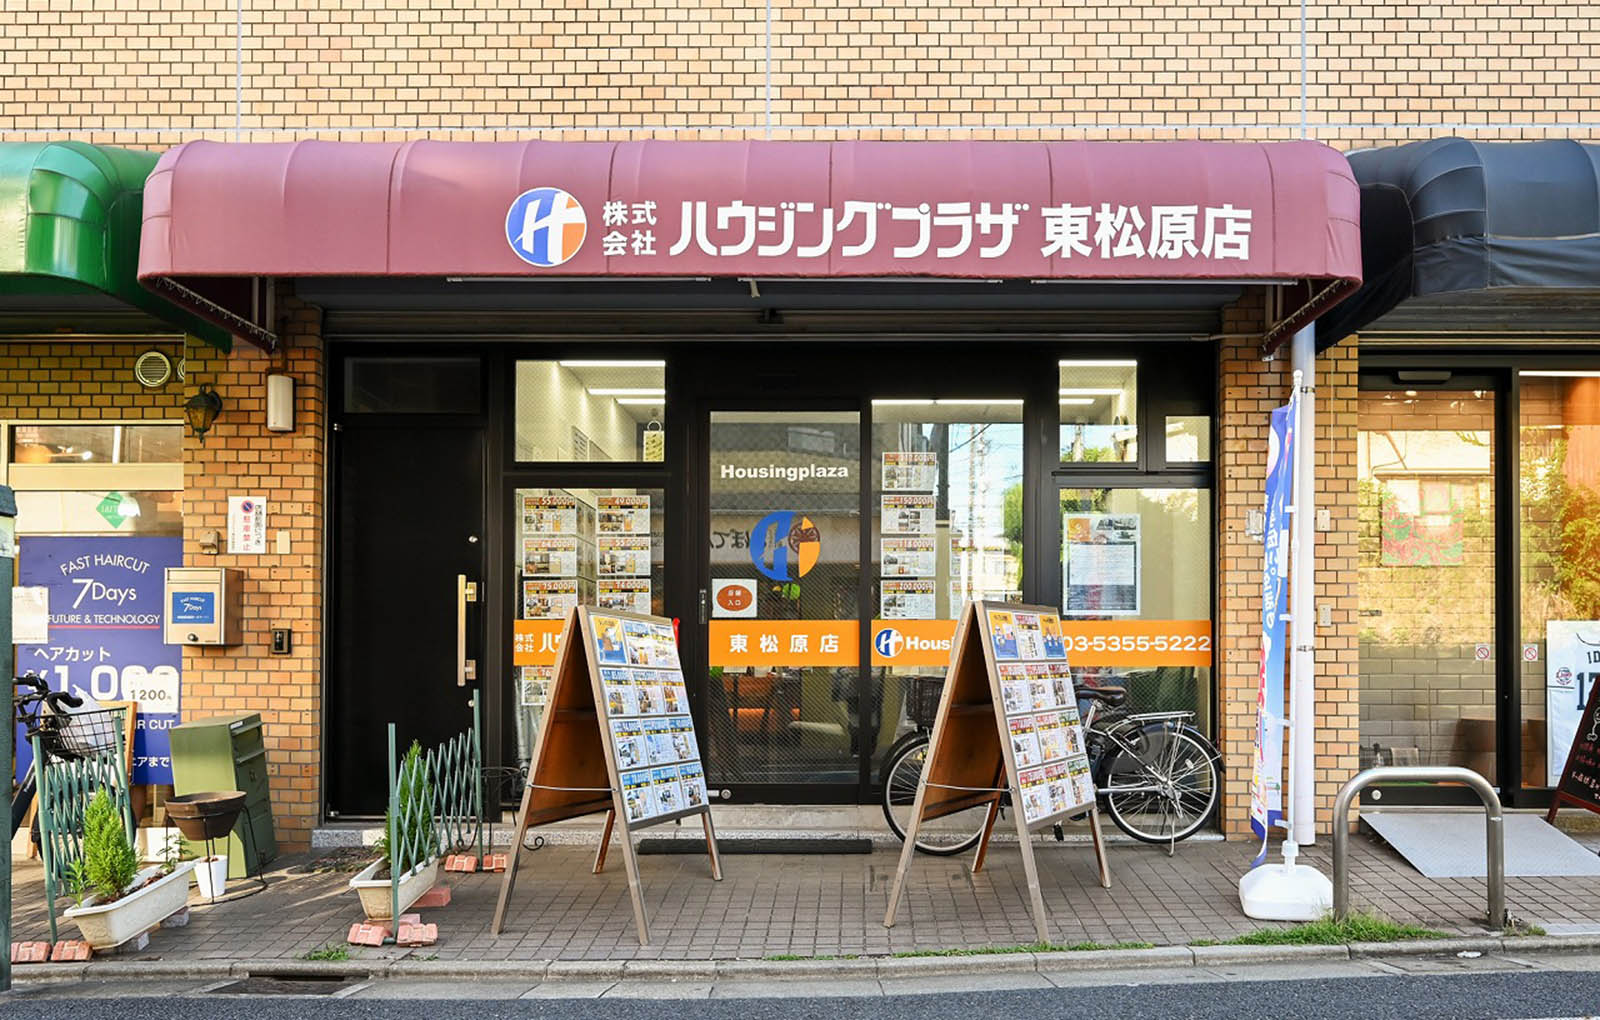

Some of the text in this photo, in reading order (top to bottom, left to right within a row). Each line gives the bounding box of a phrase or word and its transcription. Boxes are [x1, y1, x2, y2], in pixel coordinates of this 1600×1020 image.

[602, 200, 657, 226] 株式
[669, 200, 1252, 260] ハウジングプラザ 東松原店
[602, 230, 657, 256] 会社
[721, 464, 849, 481] Housingplaza
[60, 554, 150, 576] FAST HAIRCUT
[72, 579, 137, 609] 7Days
[48, 614, 161, 625] FUTURE & TECHNOLOGY
[729, 634, 839, 653] 東松原店
[1063, 635, 1212, 652] 03-5355-5222
[34, 647, 111, 662] ヘアカット
[149, 719, 175, 731] CUT
